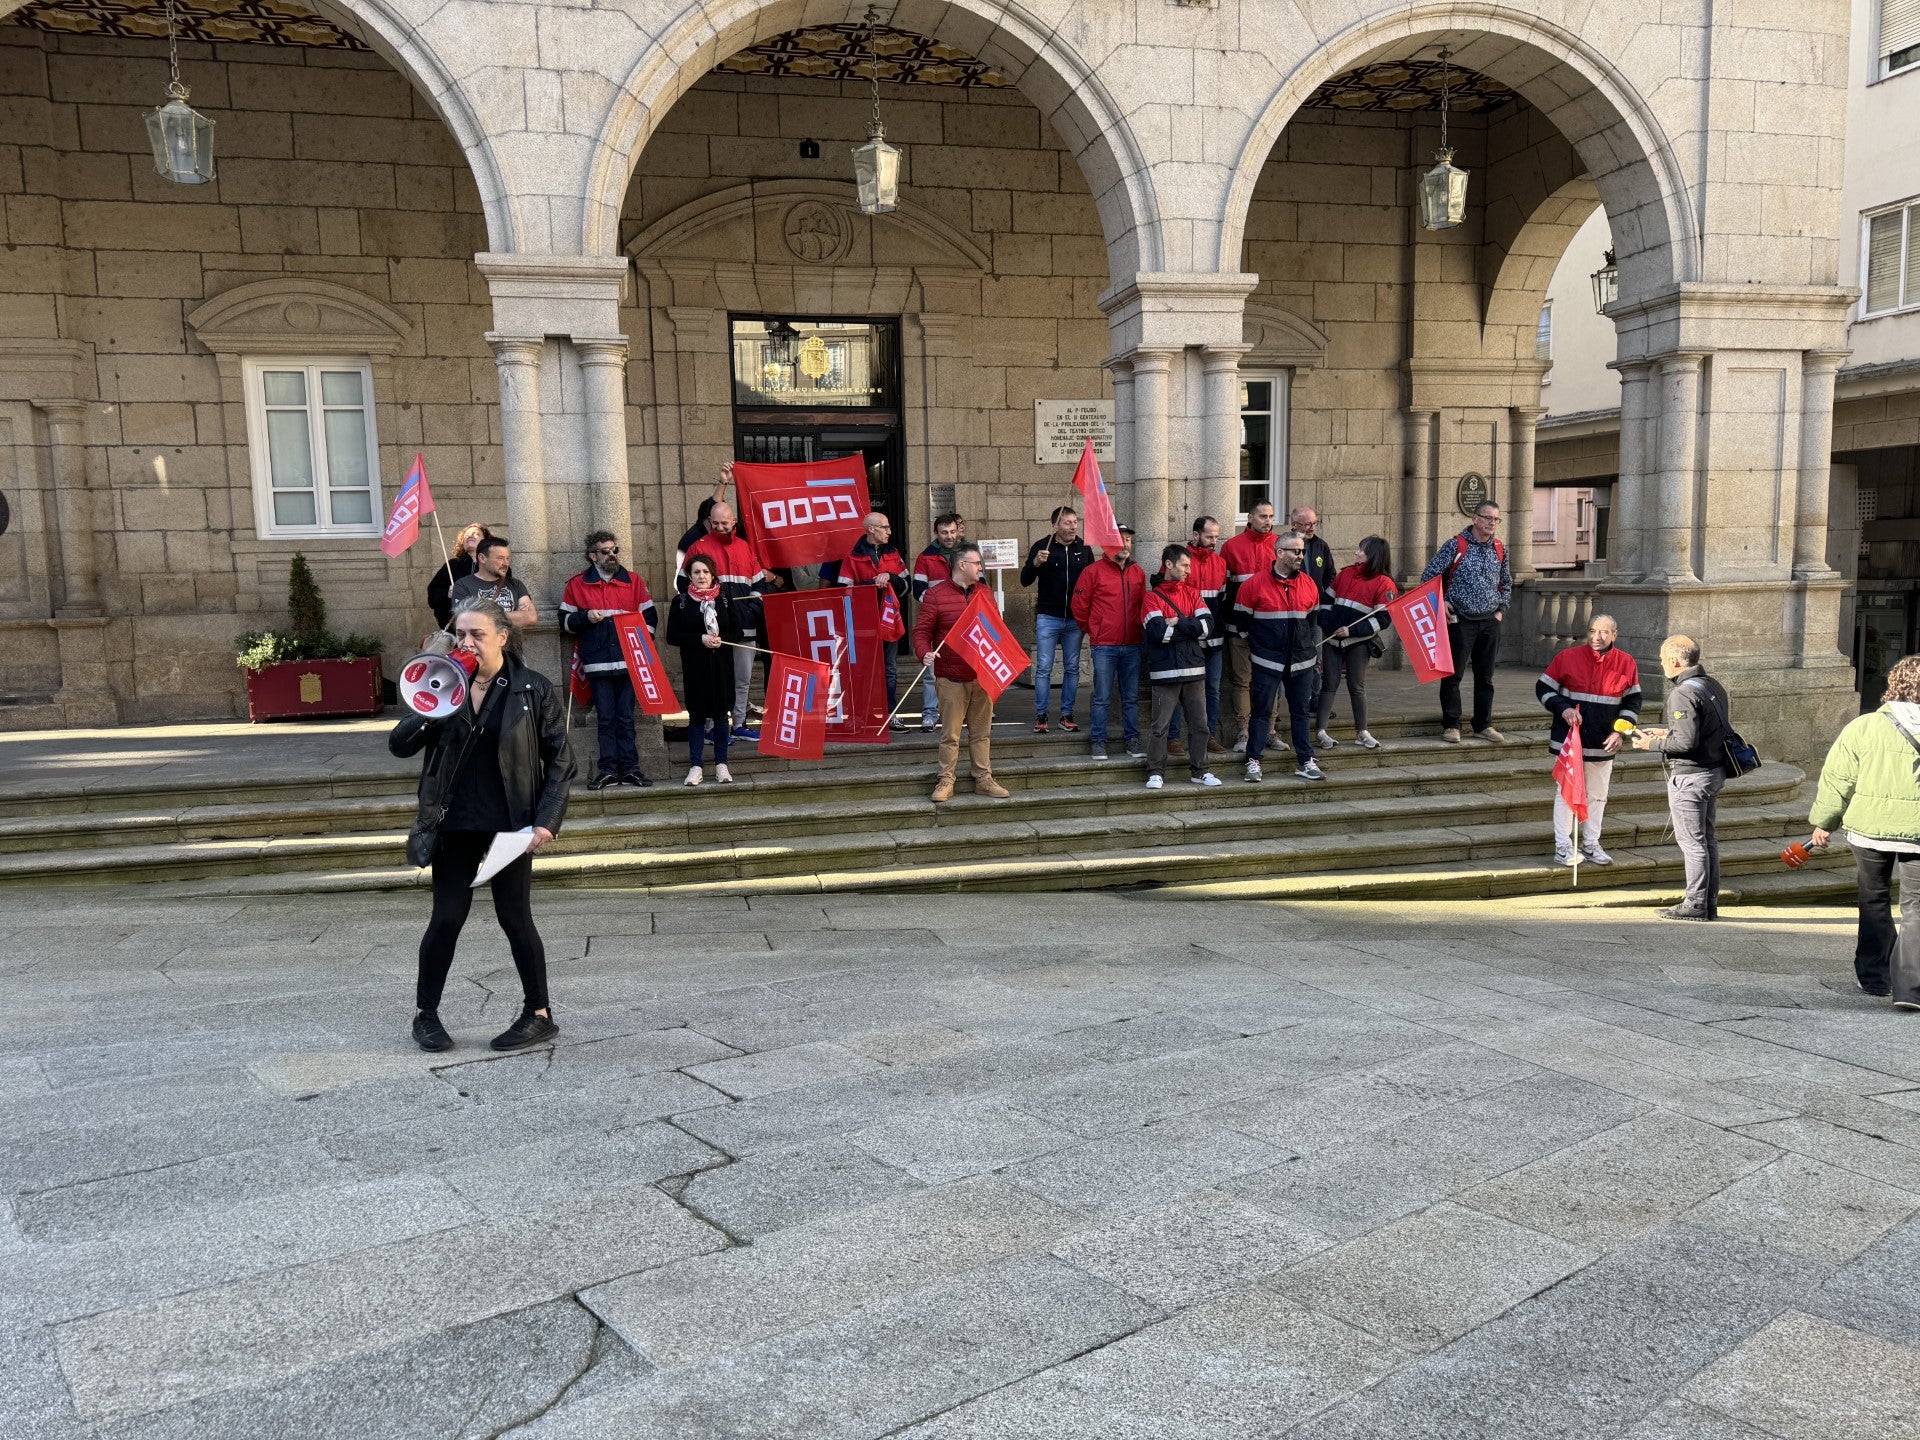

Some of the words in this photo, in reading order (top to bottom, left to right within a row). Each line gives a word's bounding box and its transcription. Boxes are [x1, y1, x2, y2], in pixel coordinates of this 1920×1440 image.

[627, 632, 658, 699] CCOO
[968, 624, 1013, 684] CCOO
[780, 674, 803, 744] CCOO
